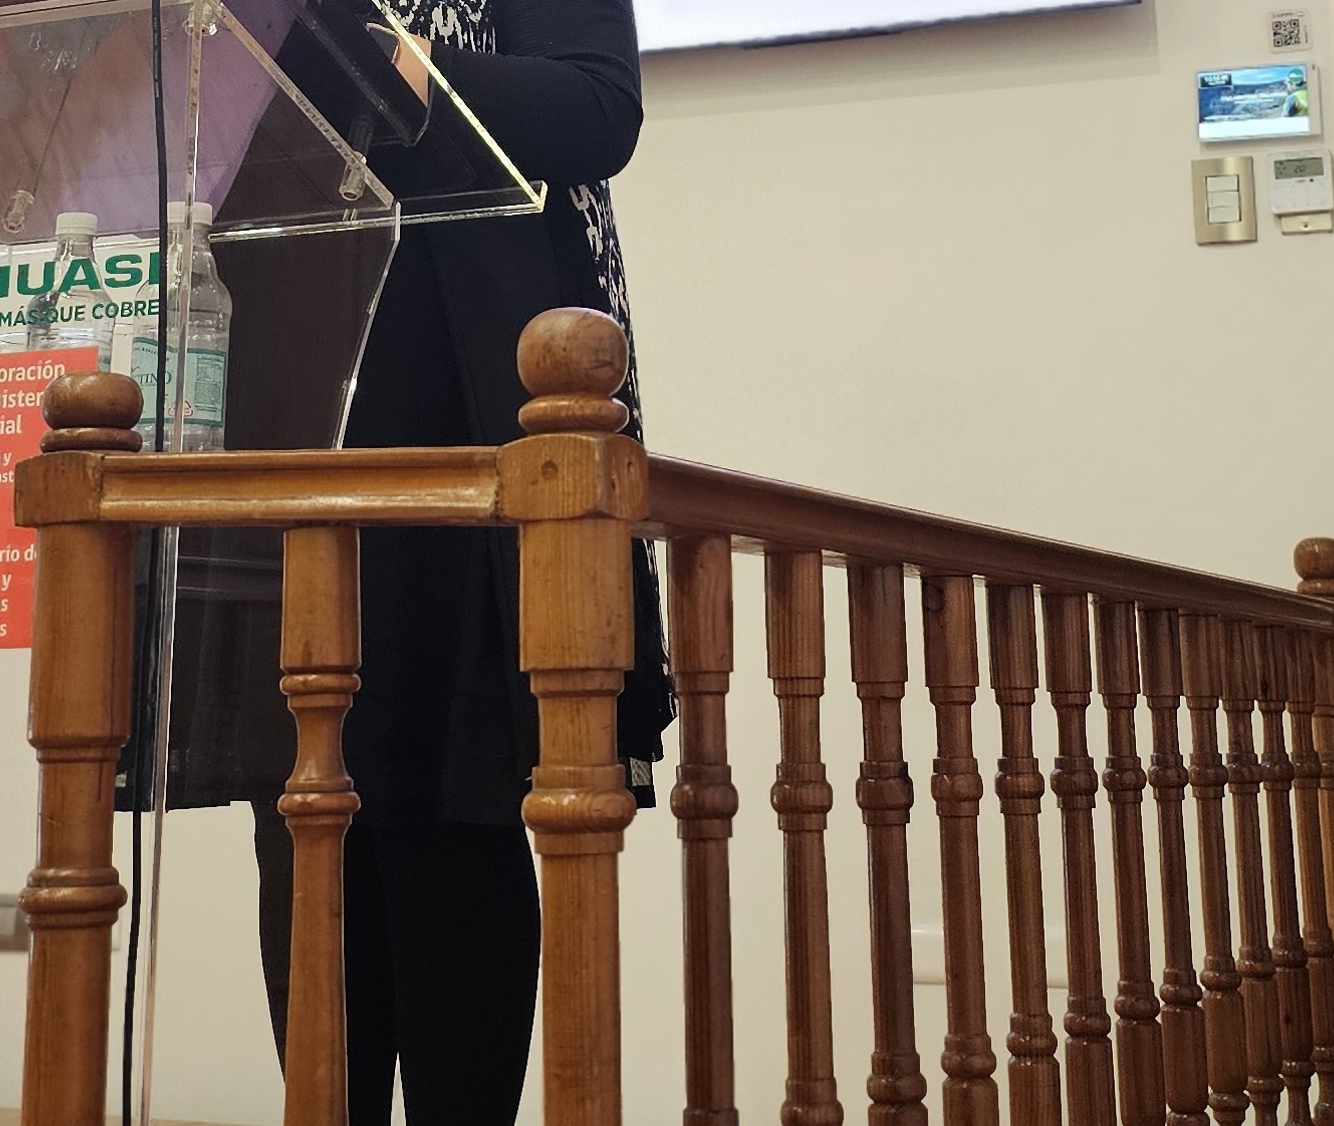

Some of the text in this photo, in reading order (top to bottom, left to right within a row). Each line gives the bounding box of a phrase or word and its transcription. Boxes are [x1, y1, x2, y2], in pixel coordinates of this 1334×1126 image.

[45, 305, 85, 325] QUE
[92, 299, 159, 320] COBRE
[3, 452, 11, 466] y
[1, 573, 11, 591] y
